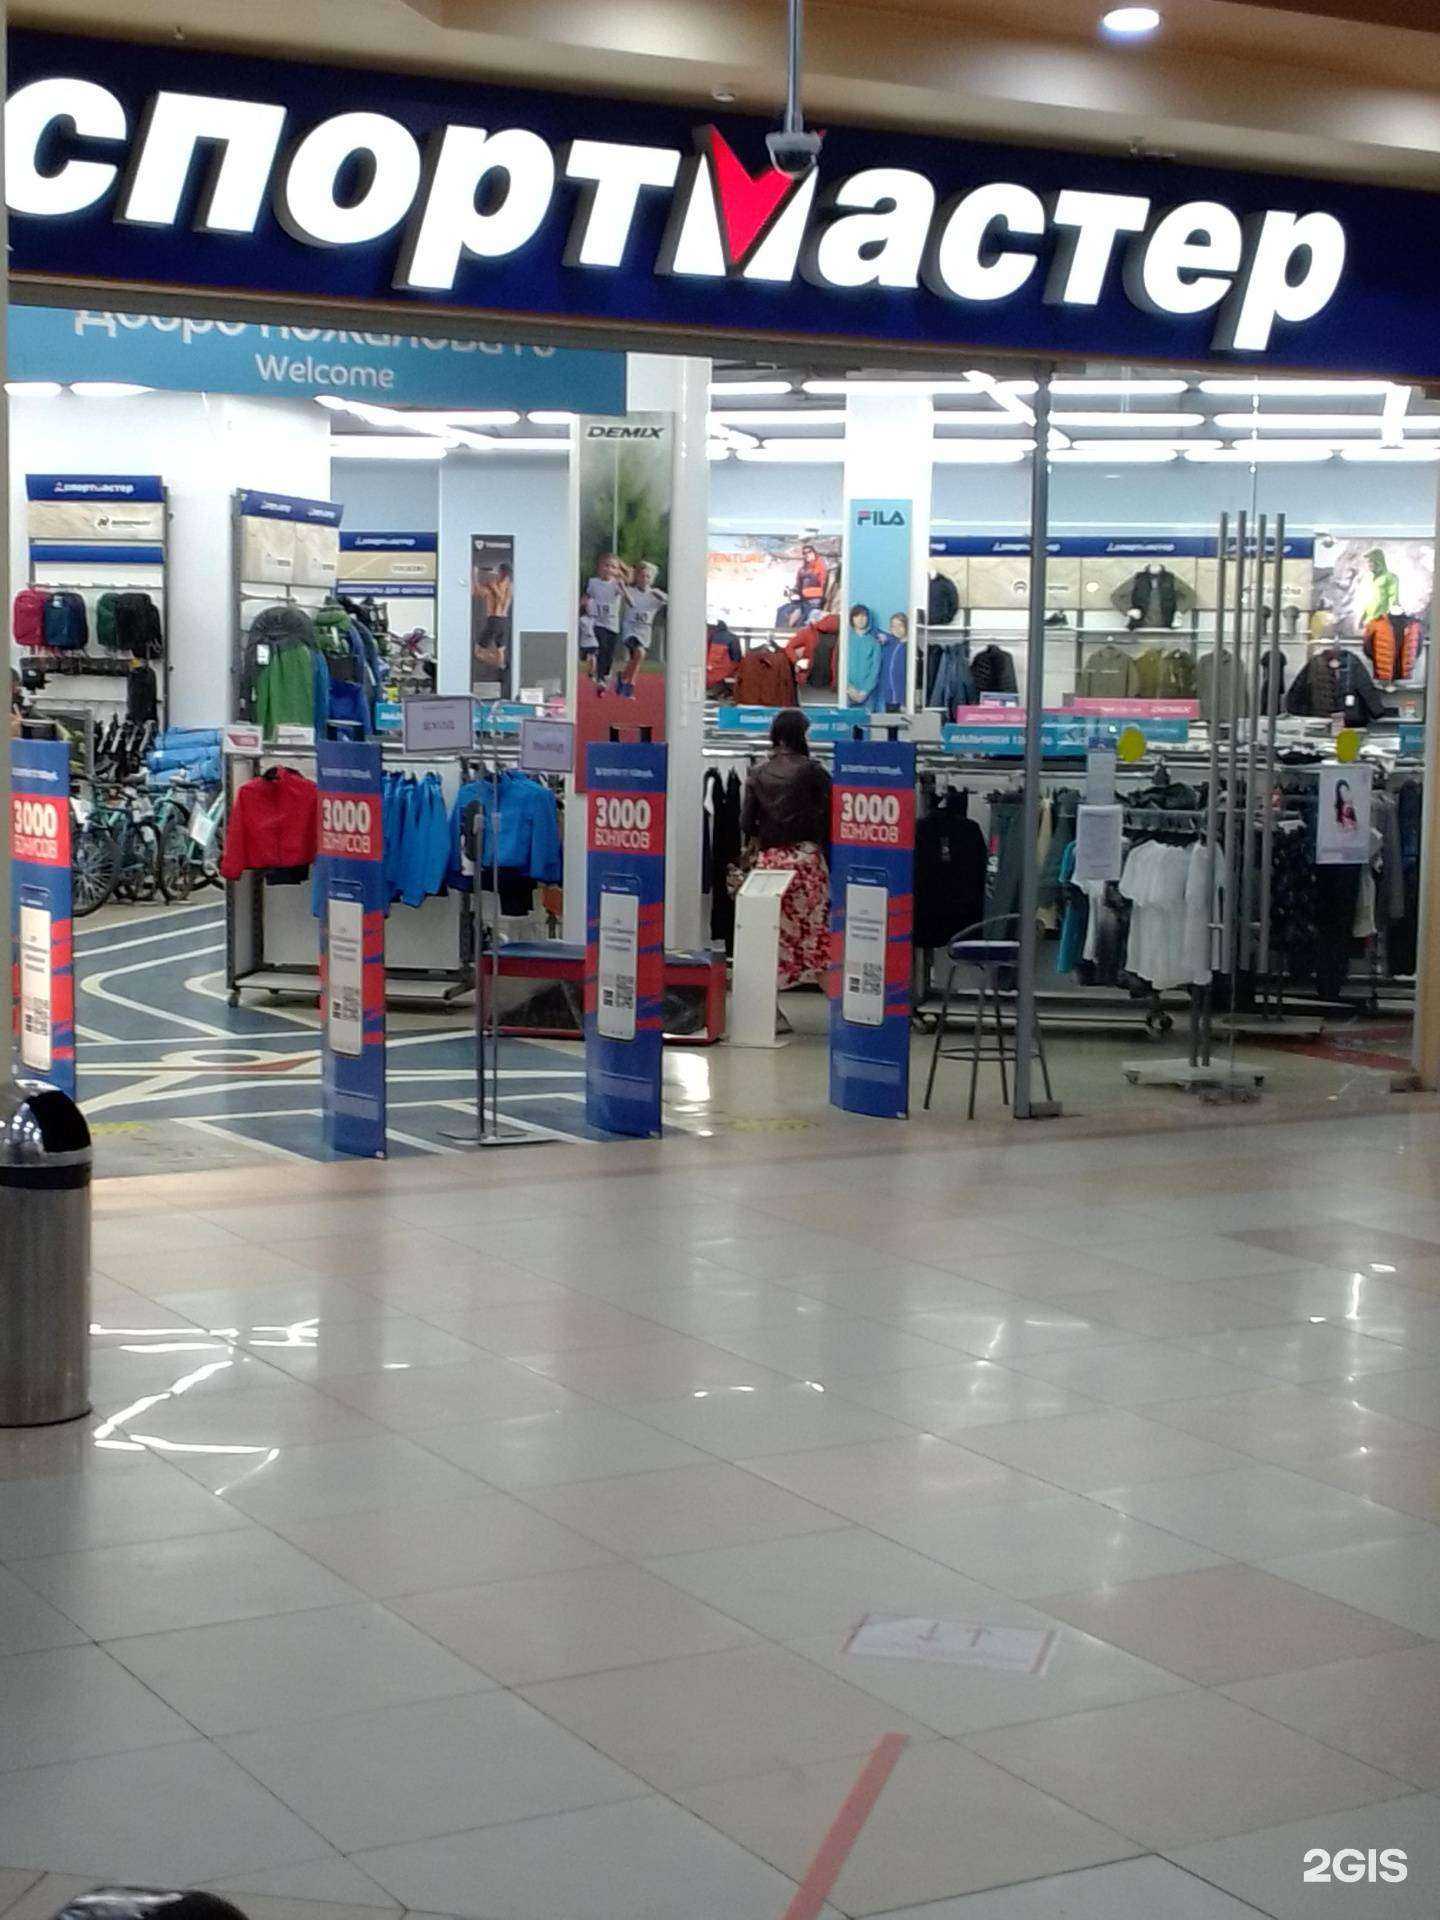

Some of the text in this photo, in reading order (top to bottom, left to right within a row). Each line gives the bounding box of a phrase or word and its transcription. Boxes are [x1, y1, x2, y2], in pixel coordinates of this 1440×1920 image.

[254, 353, 395, 389] Welcome
[587, 426, 664, 439] DEMIX
[857, 510, 905, 526] FILA
[14, 800, 58, 838] 3000
[322, 798, 371, 834] 3000
[595, 797, 651, 830] 3000
[841, 792, 900, 825] 3000
